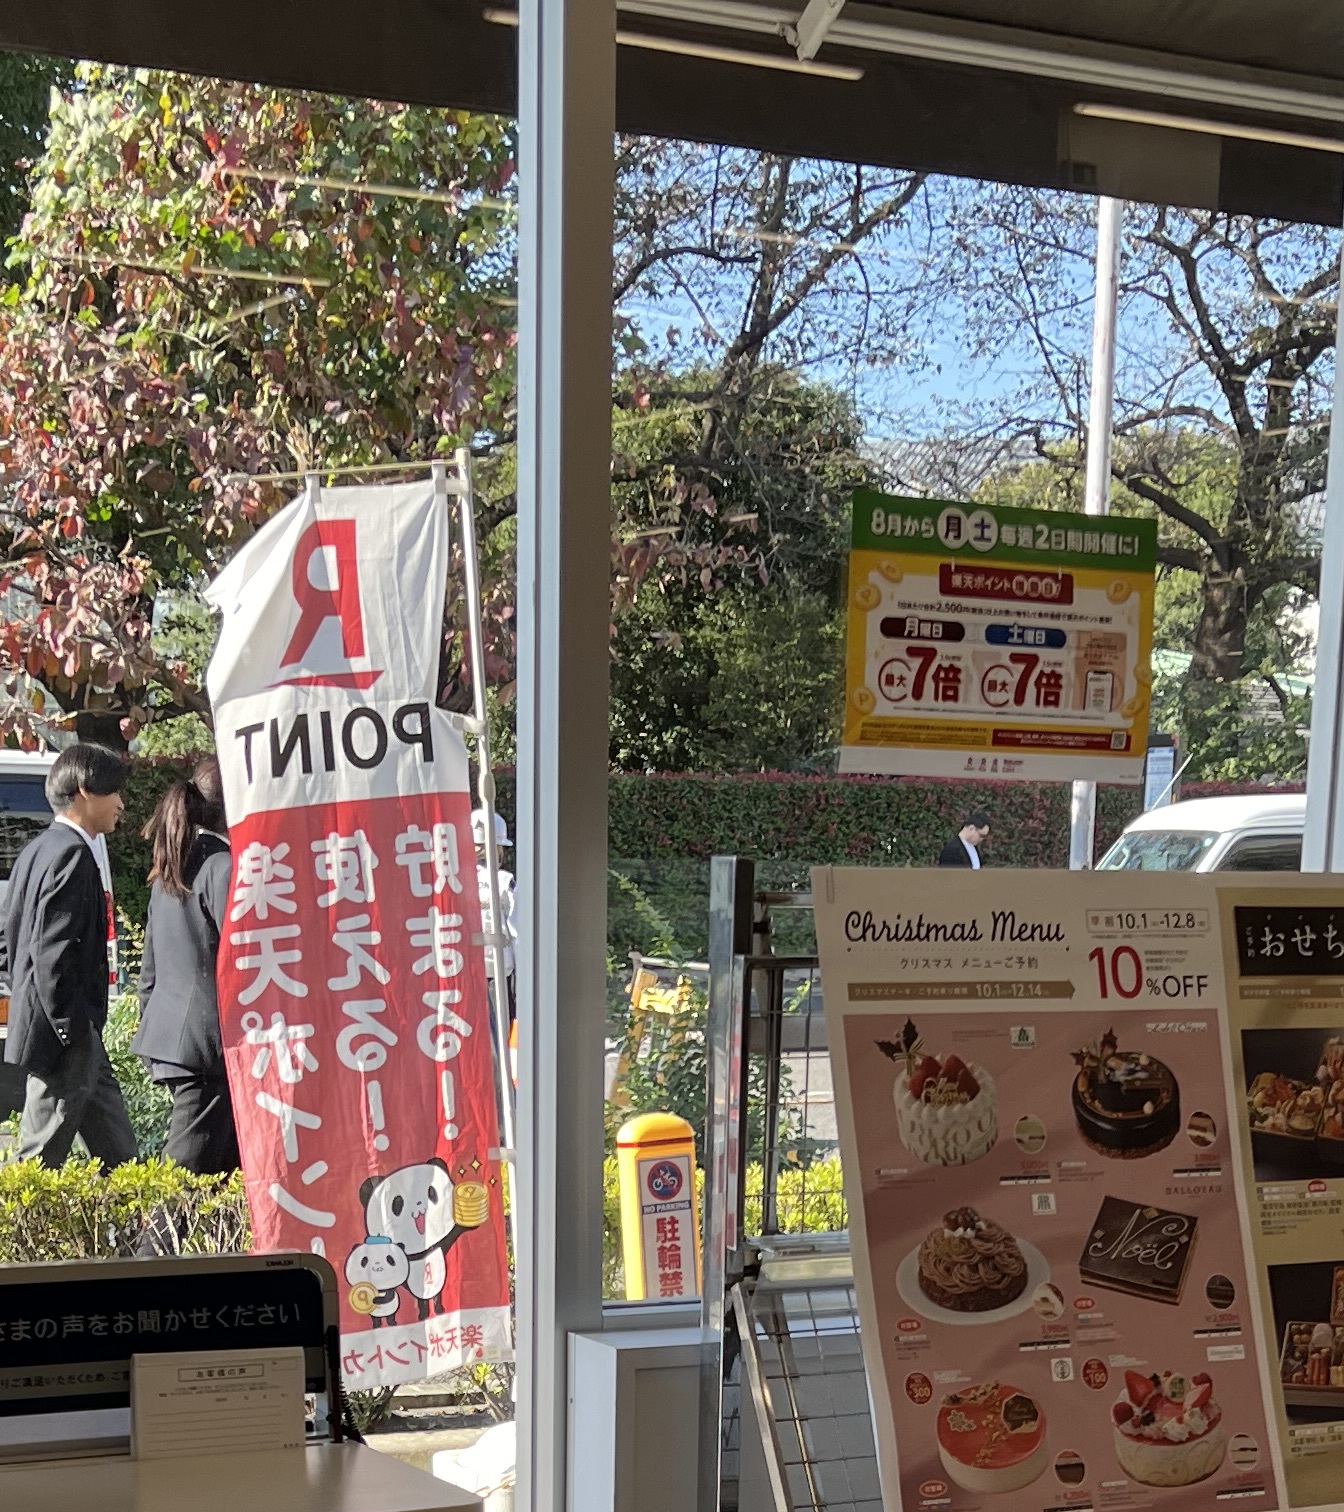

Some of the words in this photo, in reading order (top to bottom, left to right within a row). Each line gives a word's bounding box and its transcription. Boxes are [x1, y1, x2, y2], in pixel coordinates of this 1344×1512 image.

[844, 910, 984, 942] Christmas
[991, 910, 1065, 942] Menu
[900, 957, 954, 970] クリスマス
[643, 1204, 656, 1215] NO
[656, 1200, 690, 1213] PARKING
